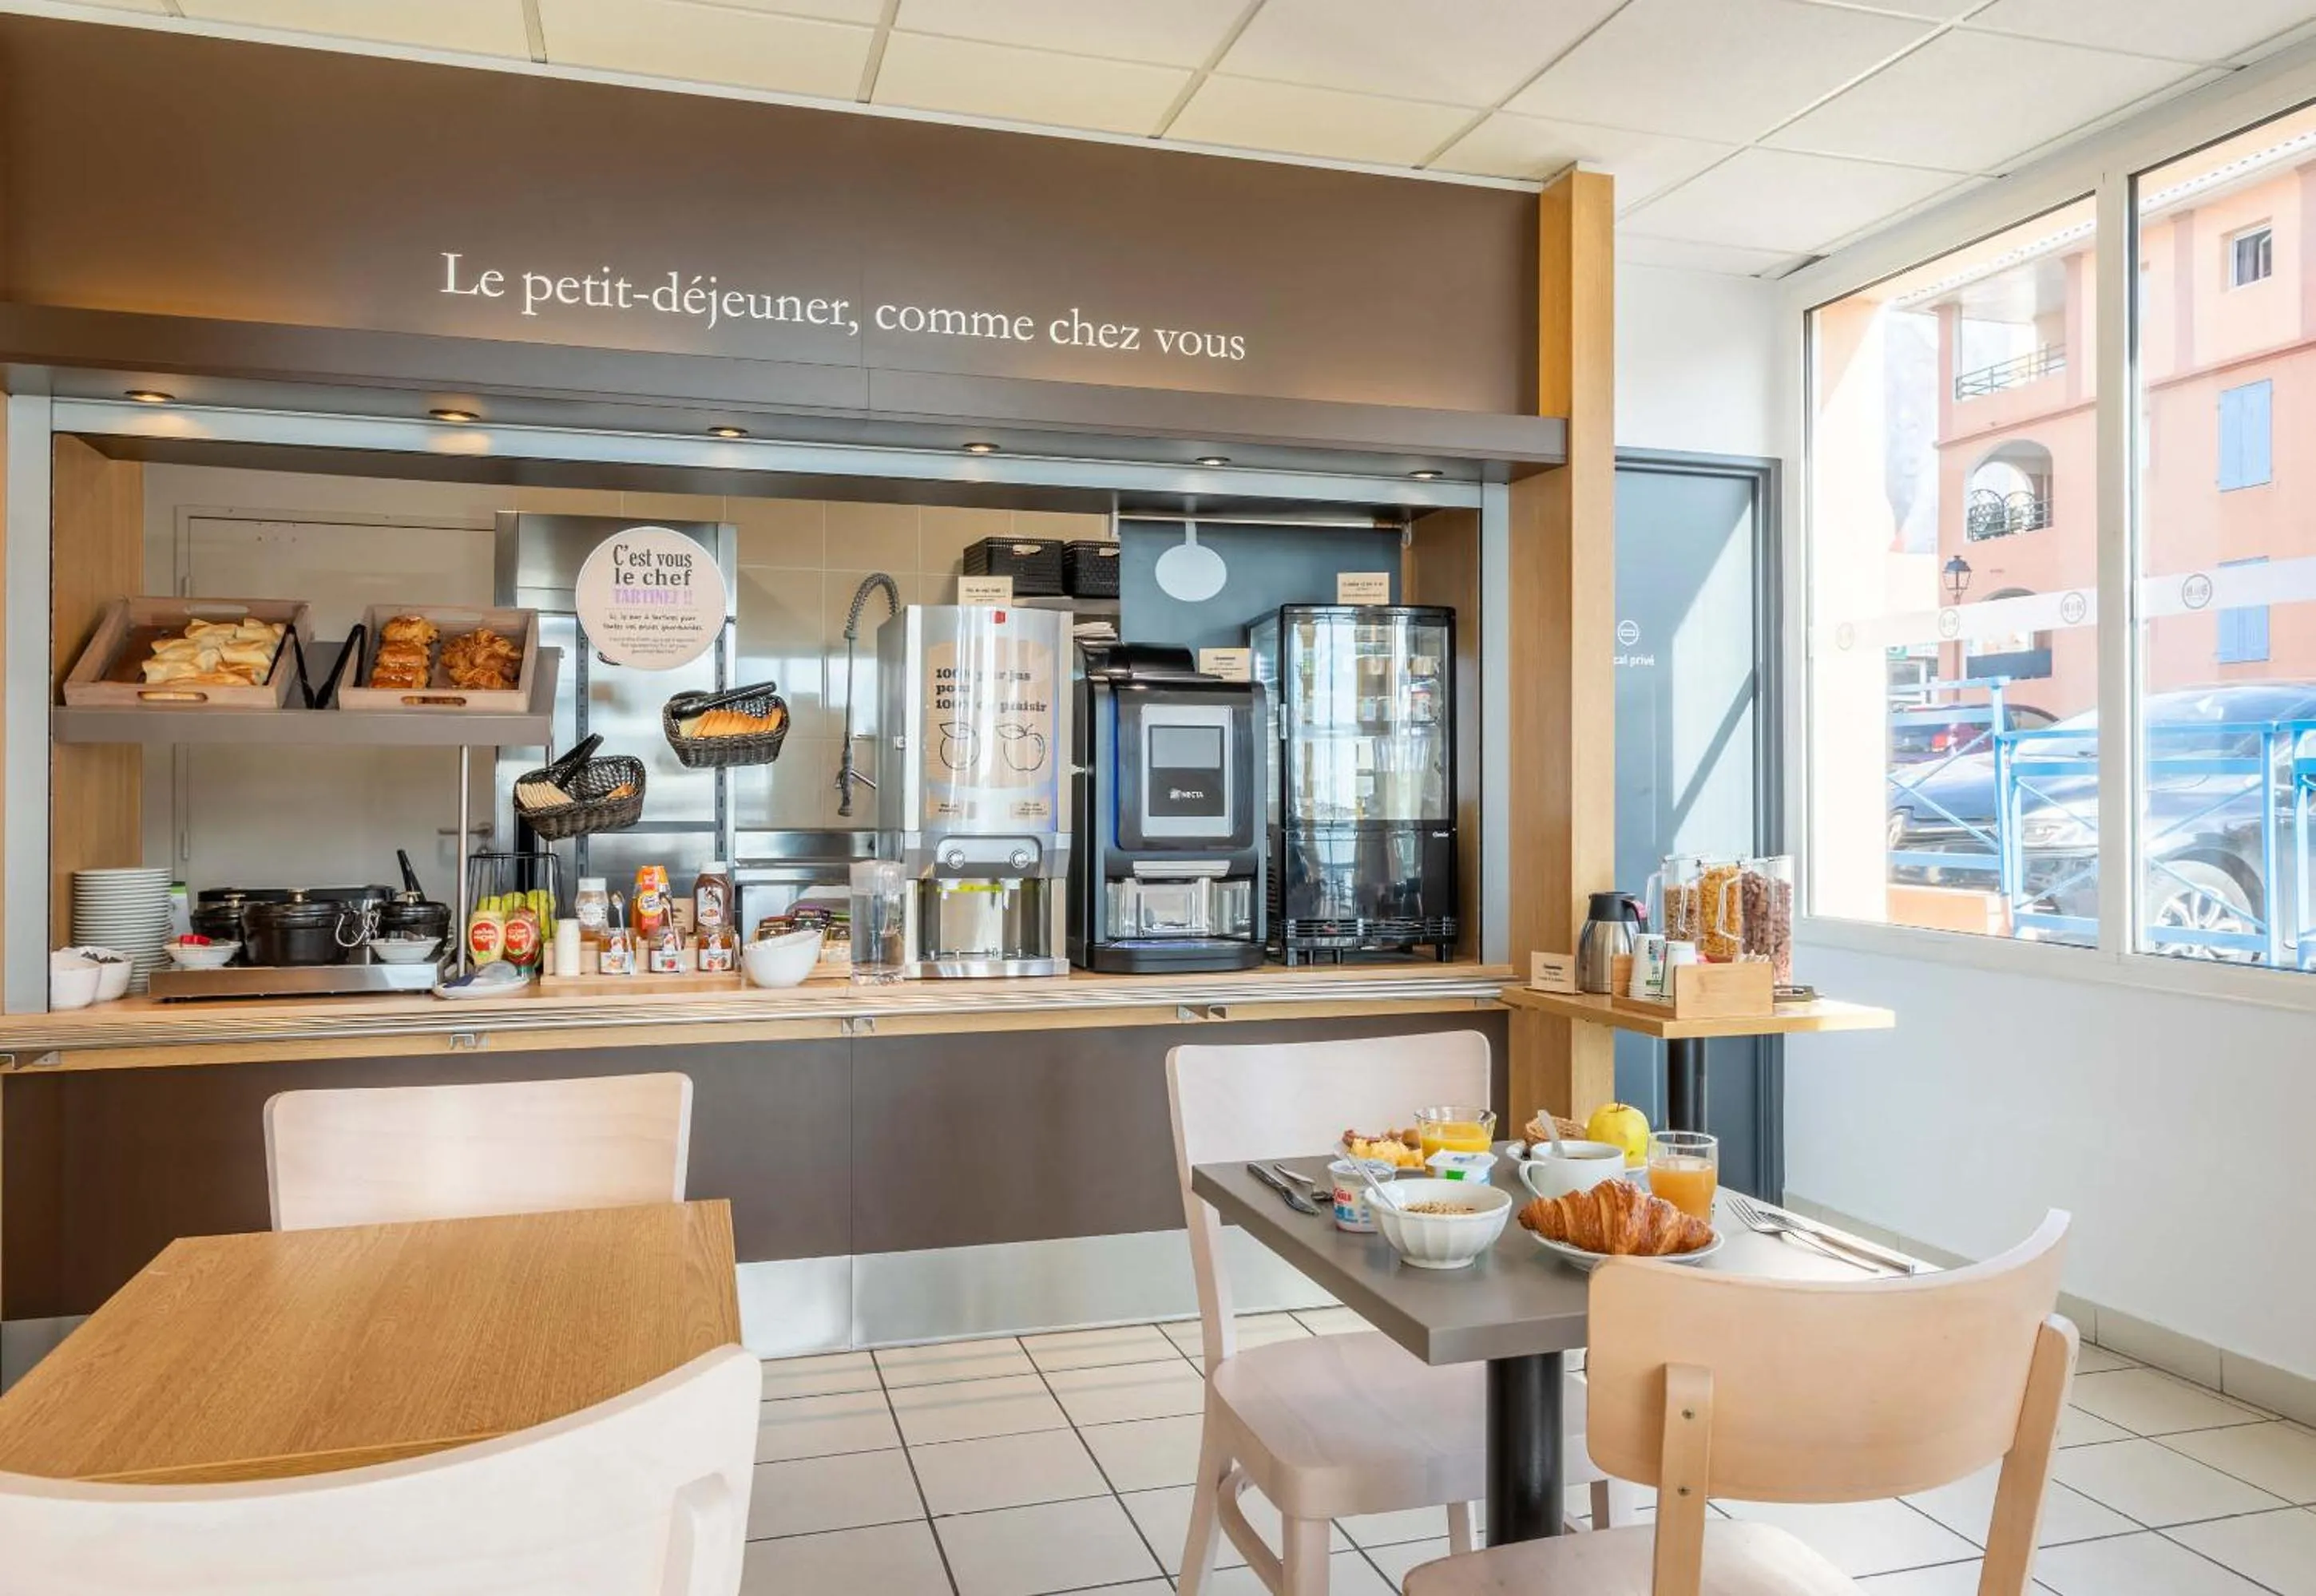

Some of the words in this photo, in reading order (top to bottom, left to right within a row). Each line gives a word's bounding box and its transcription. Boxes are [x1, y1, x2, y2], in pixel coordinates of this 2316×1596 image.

[440, 251, 505, 297] Le
[521, 266, 860, 336] petit-déjeuner,
[875, 303, 1034, 341] comme
[1049, 308, 1140, 350] chez
[1154, 328, 1247, 360] vous
[613, 545, 652, 567] C'est
[656, 552, 692, 568] vous
[615, 568, 635, 584] le
[642, 568, 692, 586] chef
